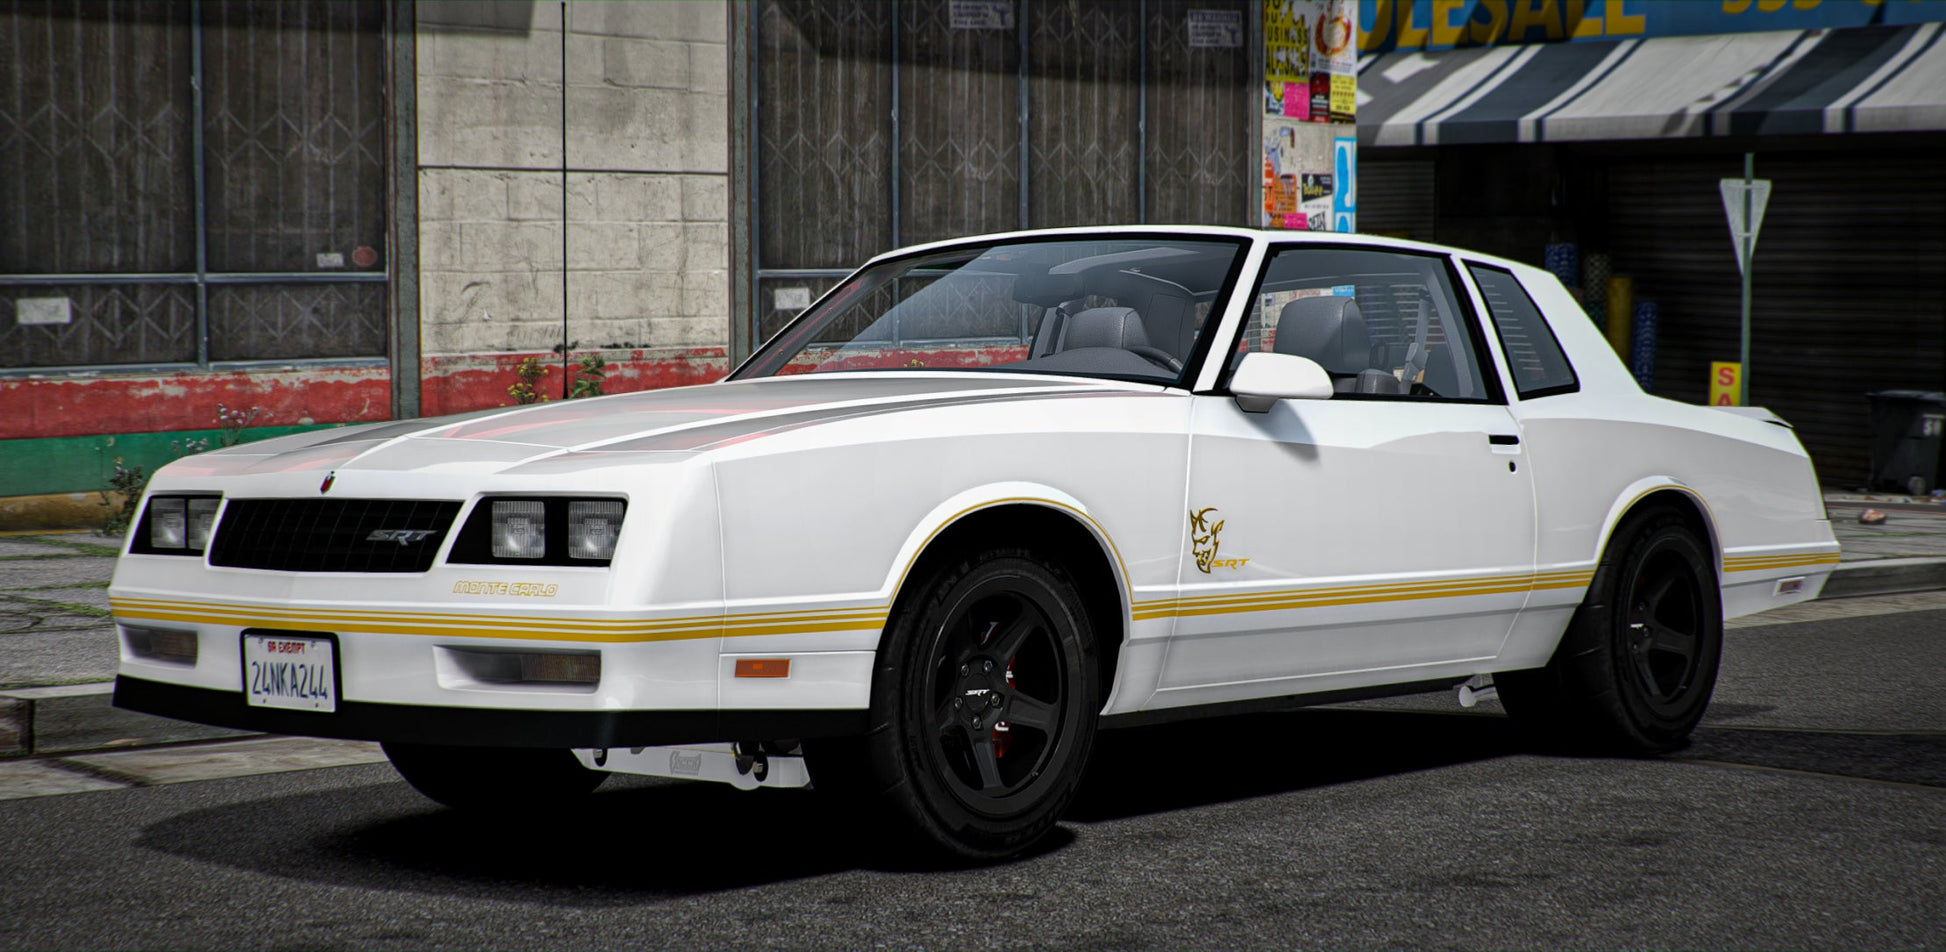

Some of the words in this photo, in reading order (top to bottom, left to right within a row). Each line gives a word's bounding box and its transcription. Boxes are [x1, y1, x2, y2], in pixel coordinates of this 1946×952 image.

[365, 529, 438, 547] SRT
[1211, 558, 1250, 570] SRT
[453, 581, 508, 596] MONTE
[509, 583, 559, 598] CARLO
[278, 642, 306, 654] EXEMPT
[252, 661, 328, 700] 24NKA244
